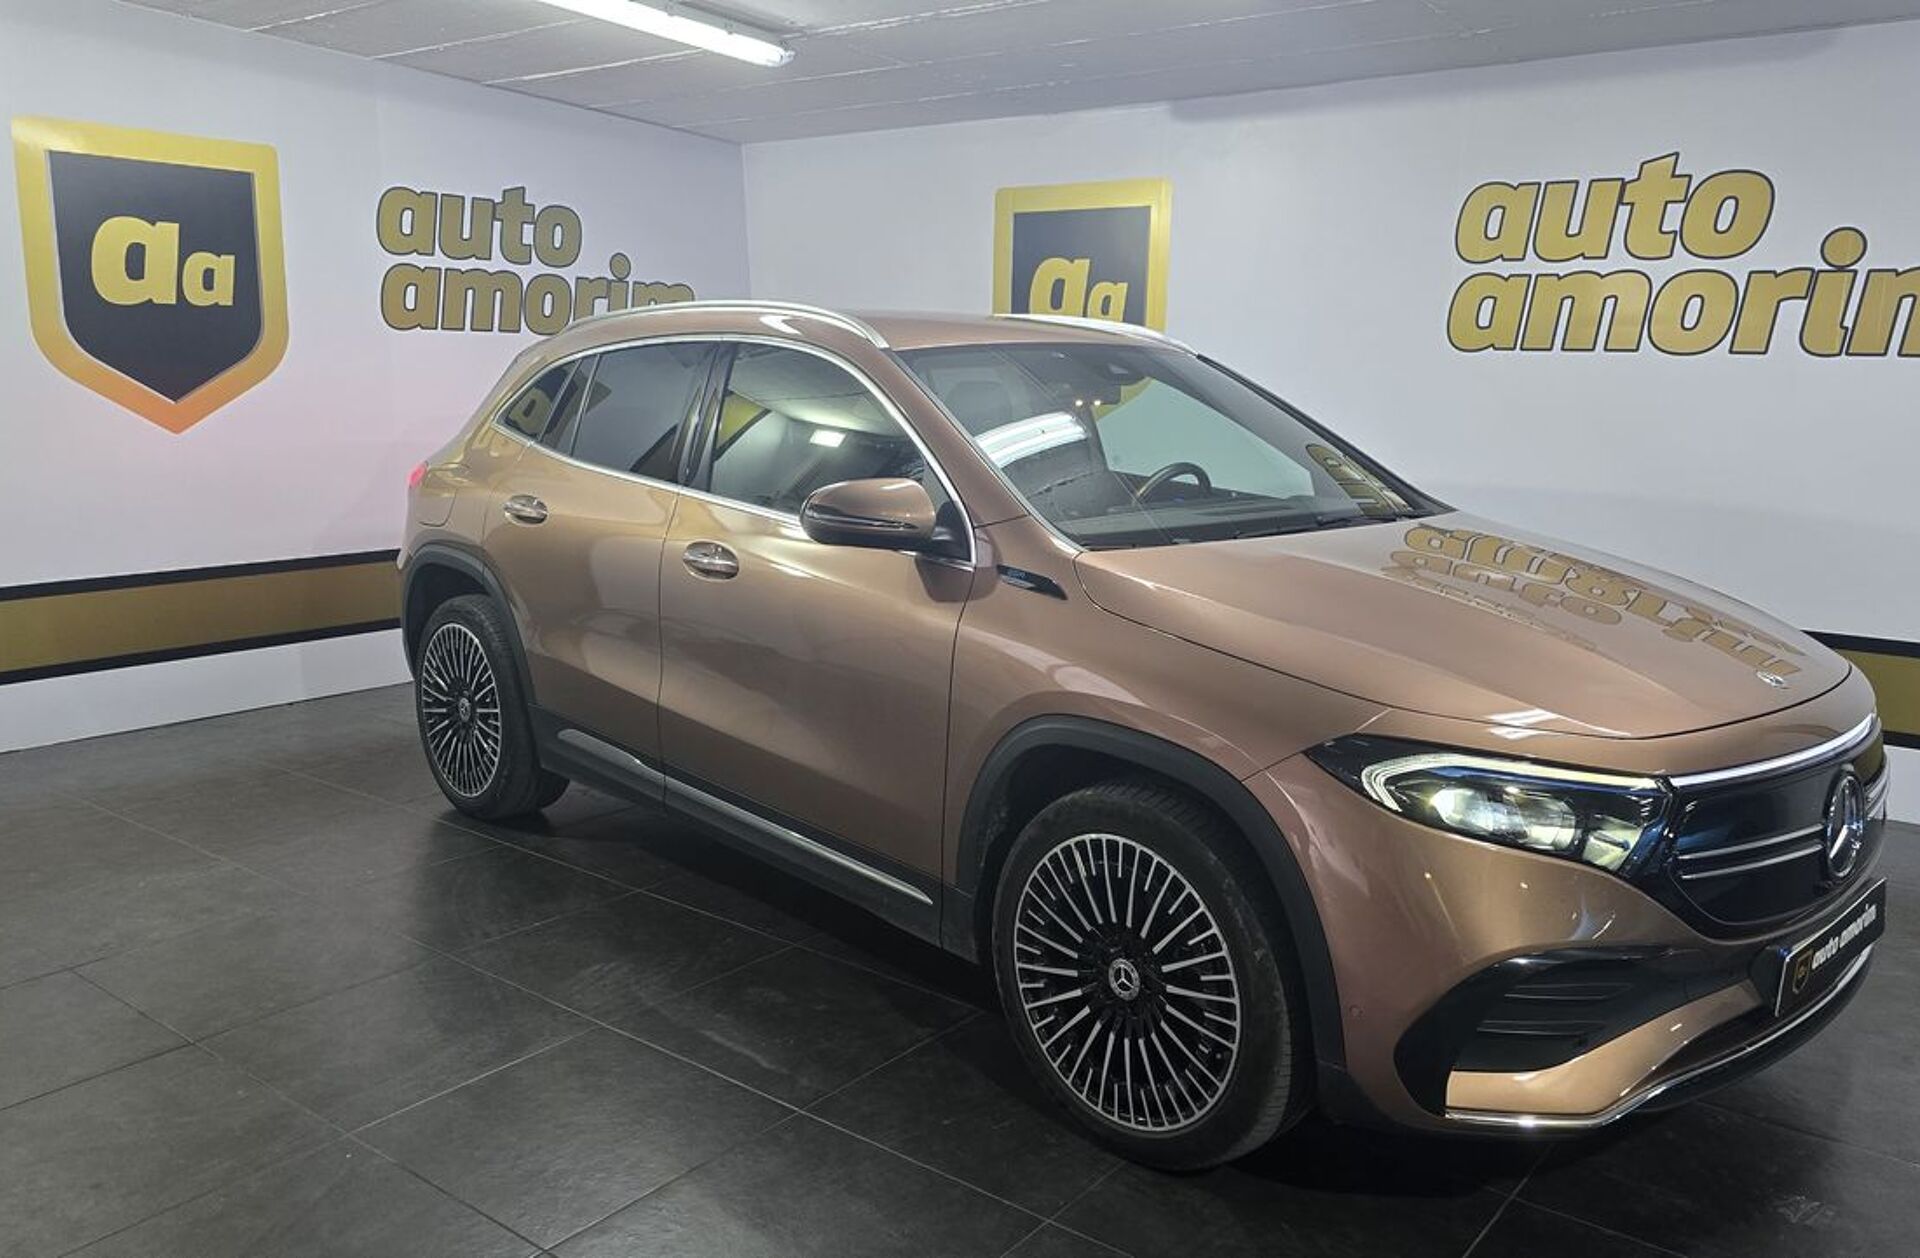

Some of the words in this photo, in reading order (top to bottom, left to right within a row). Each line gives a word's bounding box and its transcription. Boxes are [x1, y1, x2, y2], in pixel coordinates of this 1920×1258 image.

[376, 186, 582, 267] auto
[1455, 152, 1775, 264] auto
[91, 215, 235, 306] aa
